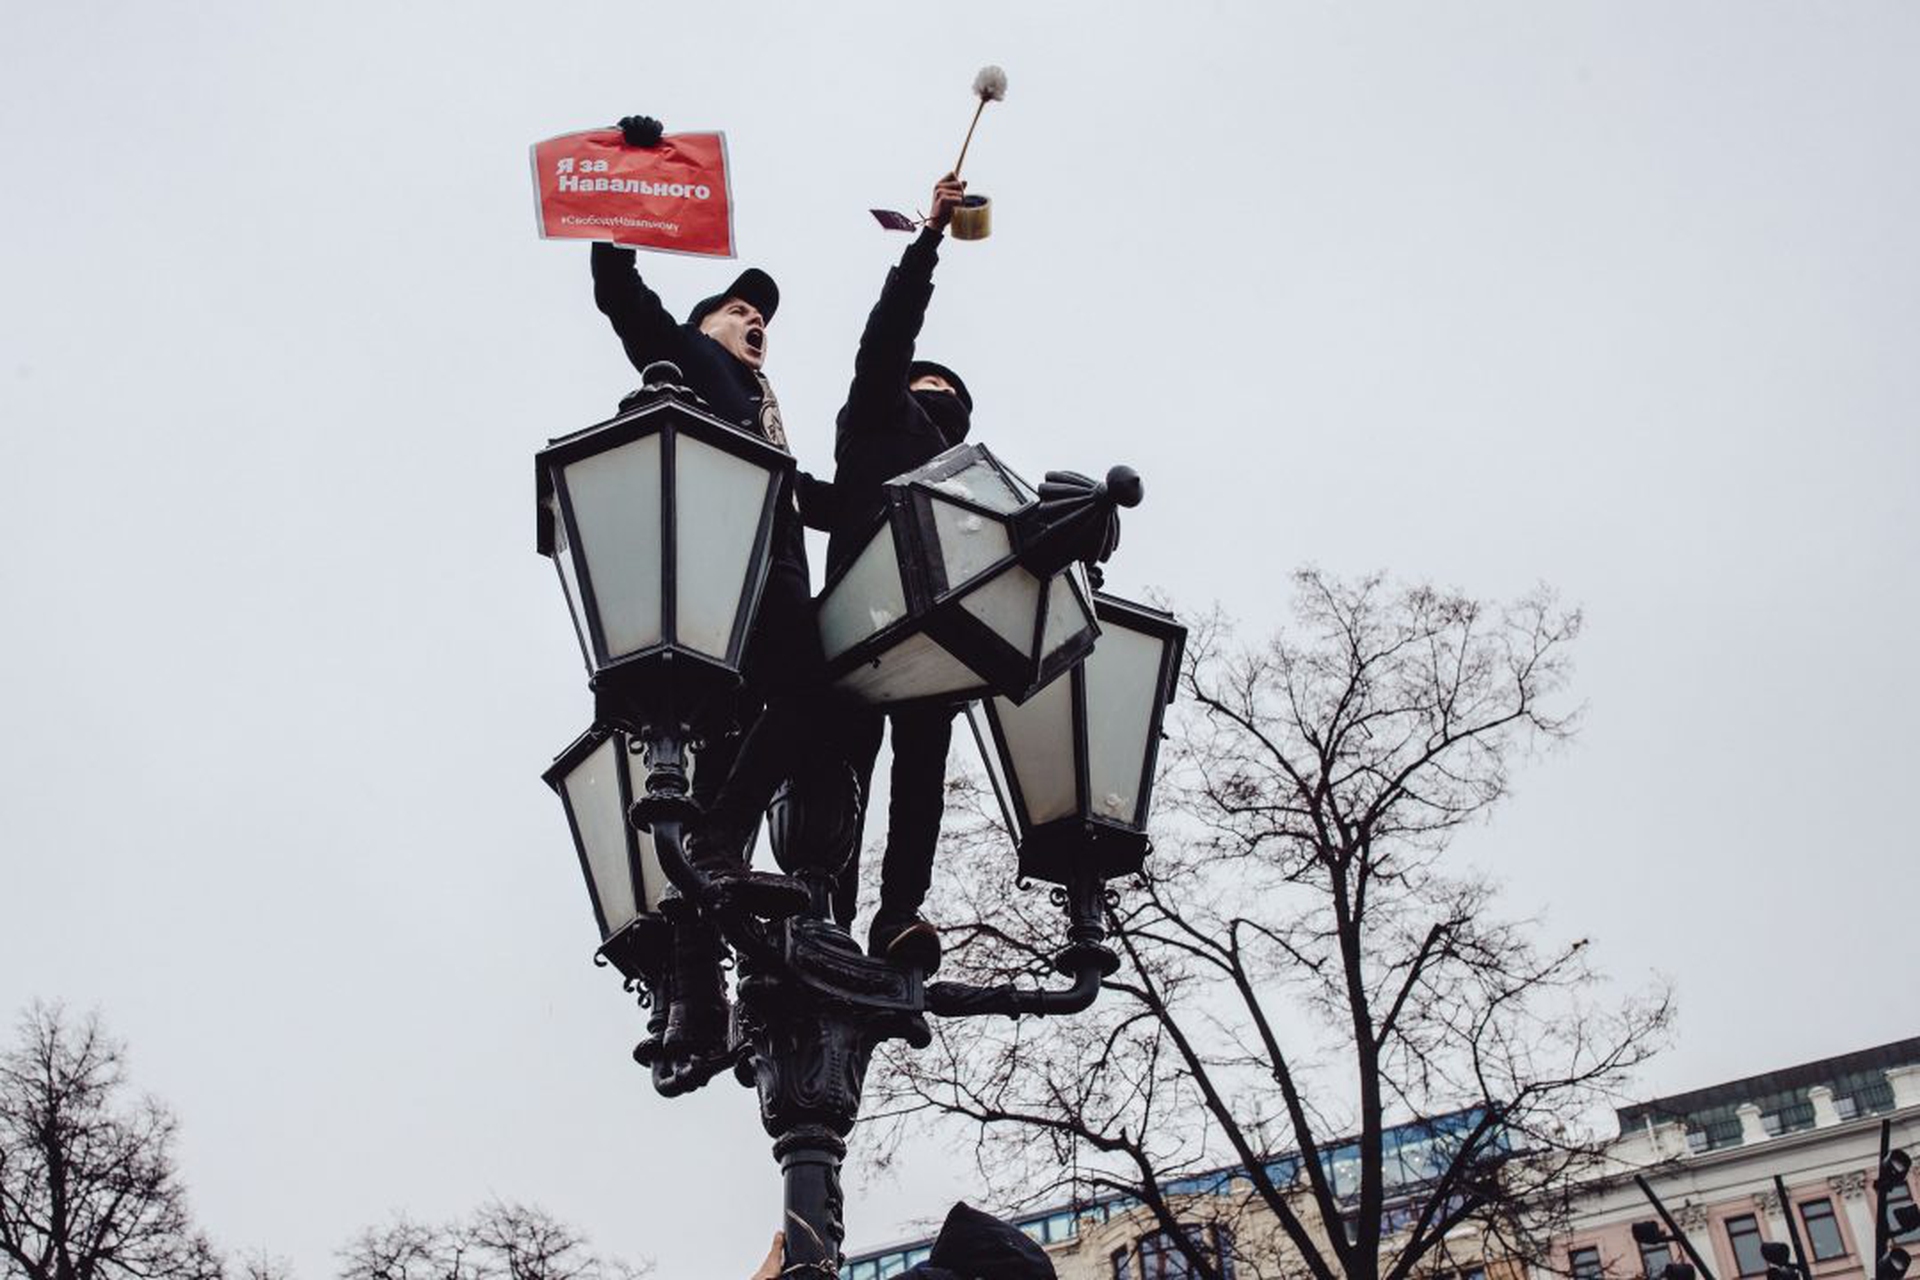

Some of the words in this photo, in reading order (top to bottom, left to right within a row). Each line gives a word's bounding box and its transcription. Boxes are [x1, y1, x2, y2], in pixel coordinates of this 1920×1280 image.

[556, 157, 574, 175] Я
[580, 159, 608, 172] за
[558, 175, 710, 199] Навального
